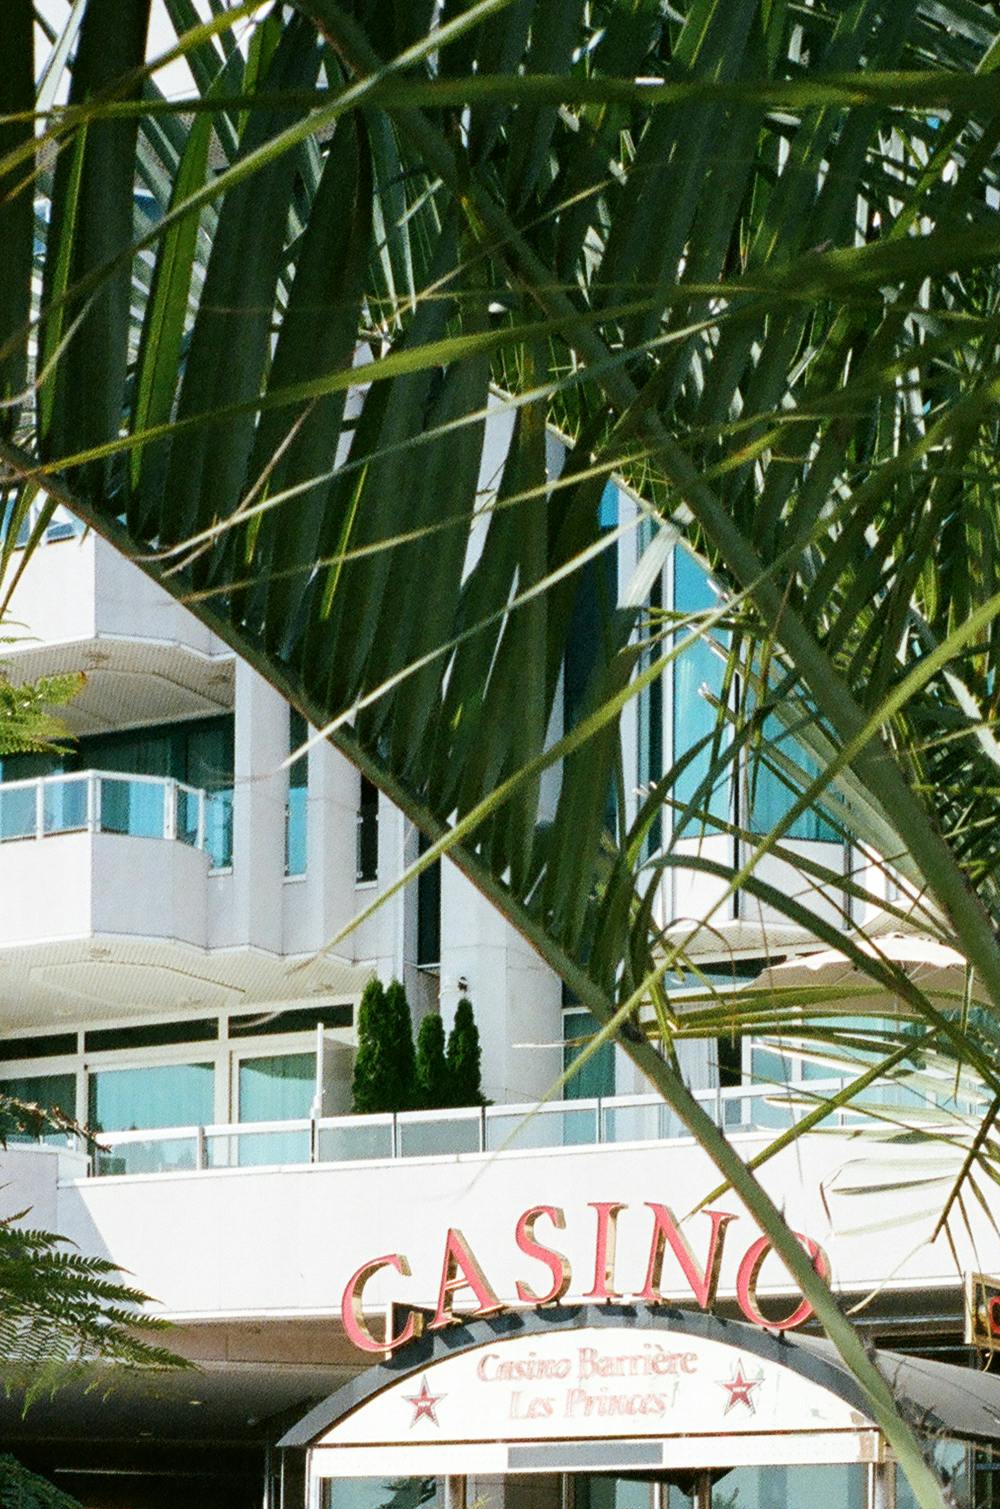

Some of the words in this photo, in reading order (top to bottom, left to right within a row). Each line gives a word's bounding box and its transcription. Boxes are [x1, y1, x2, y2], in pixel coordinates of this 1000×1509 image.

[341, 1201, 833, 1353] CASINO
[476, 1351, 573, 1383] Casino
[577, 1343, 700, 1380] Barrière
[507, 1389, 556, 1420] Les
[562, 1385, 671, 1418] Princes
